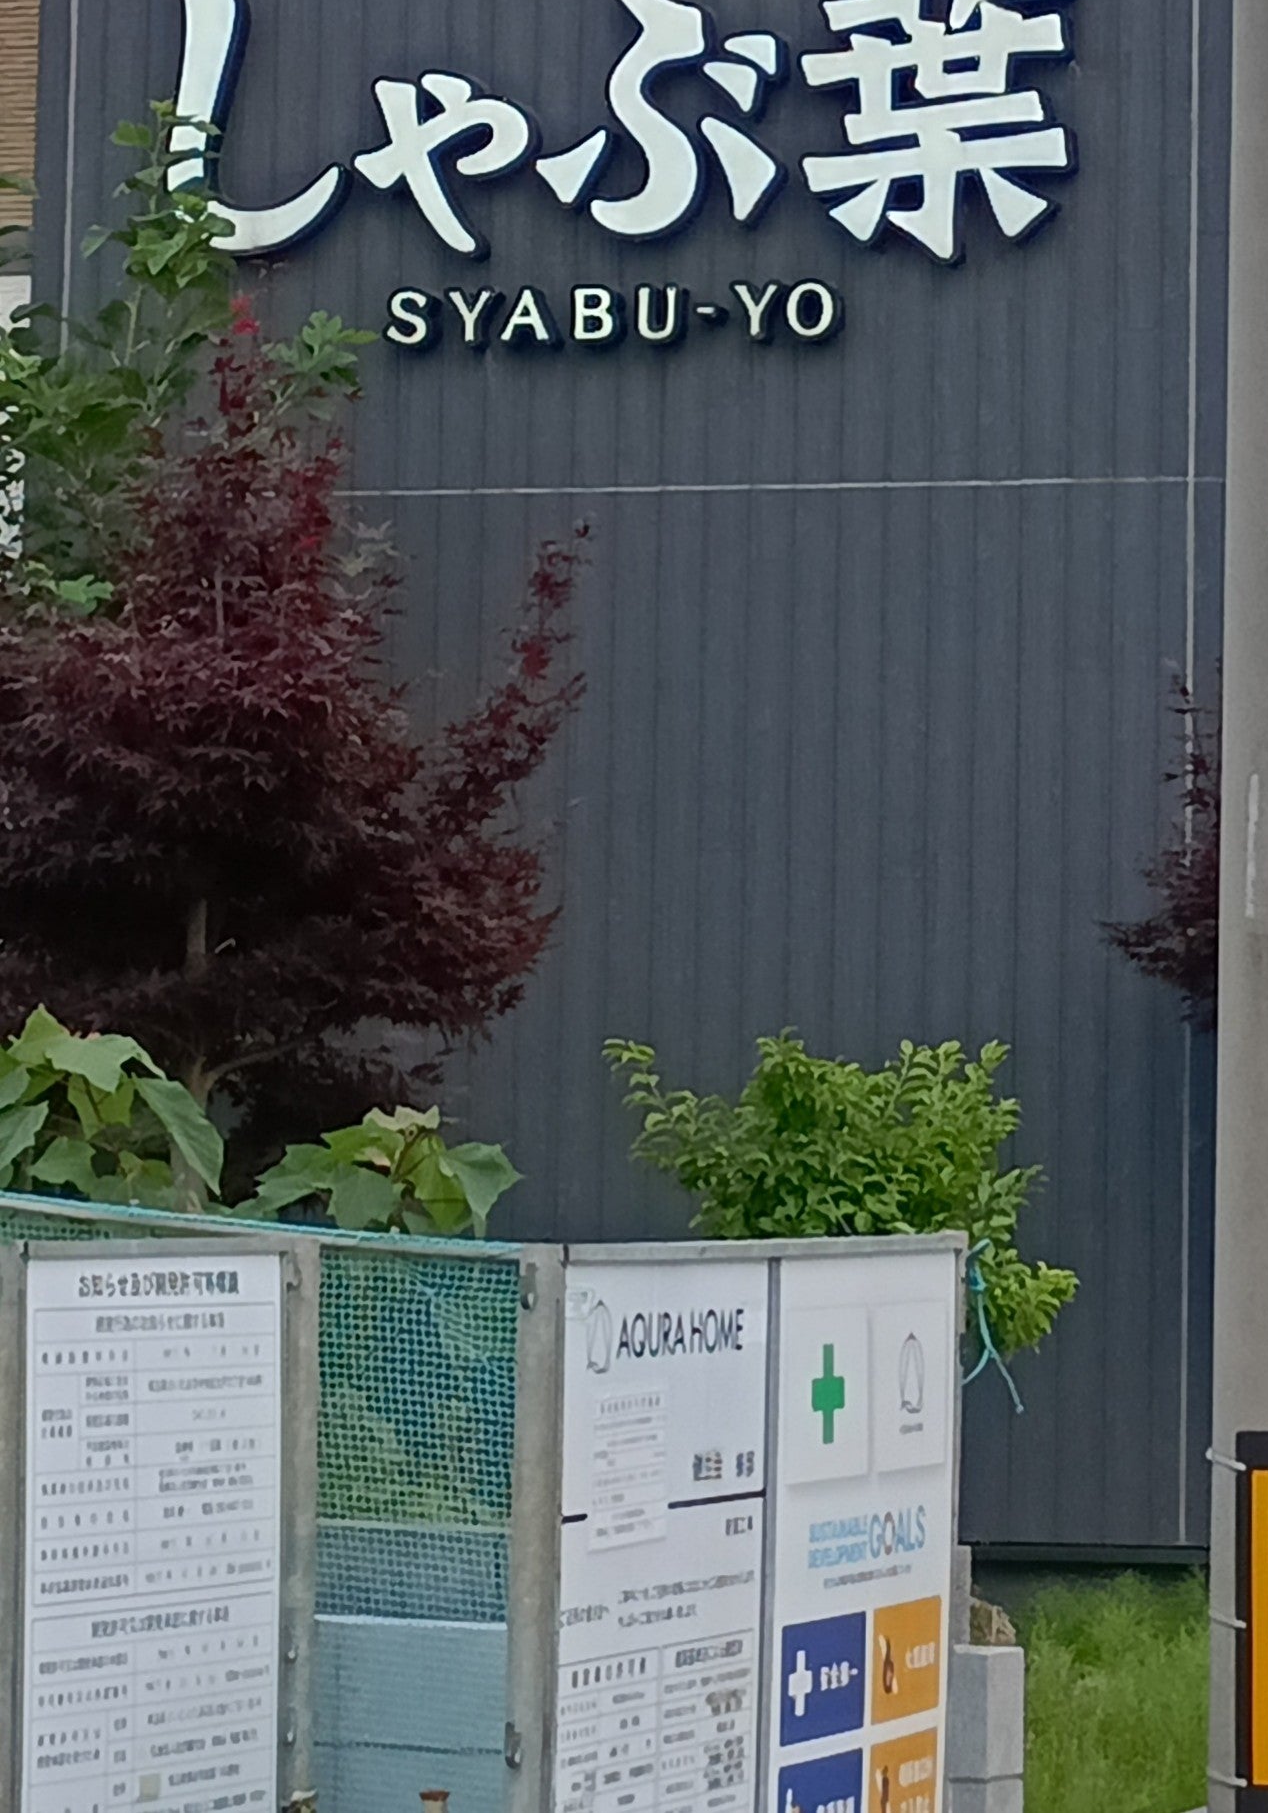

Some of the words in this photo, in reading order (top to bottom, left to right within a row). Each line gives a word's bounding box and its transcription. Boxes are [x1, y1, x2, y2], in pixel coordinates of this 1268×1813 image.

[387, 281, 835, 345] SYABU-YO
[616, 1310, 687, 1360] AQURA
[690, 1308, 744, 1355] HOME
[869, 1504, 926, 1559] GOALS
